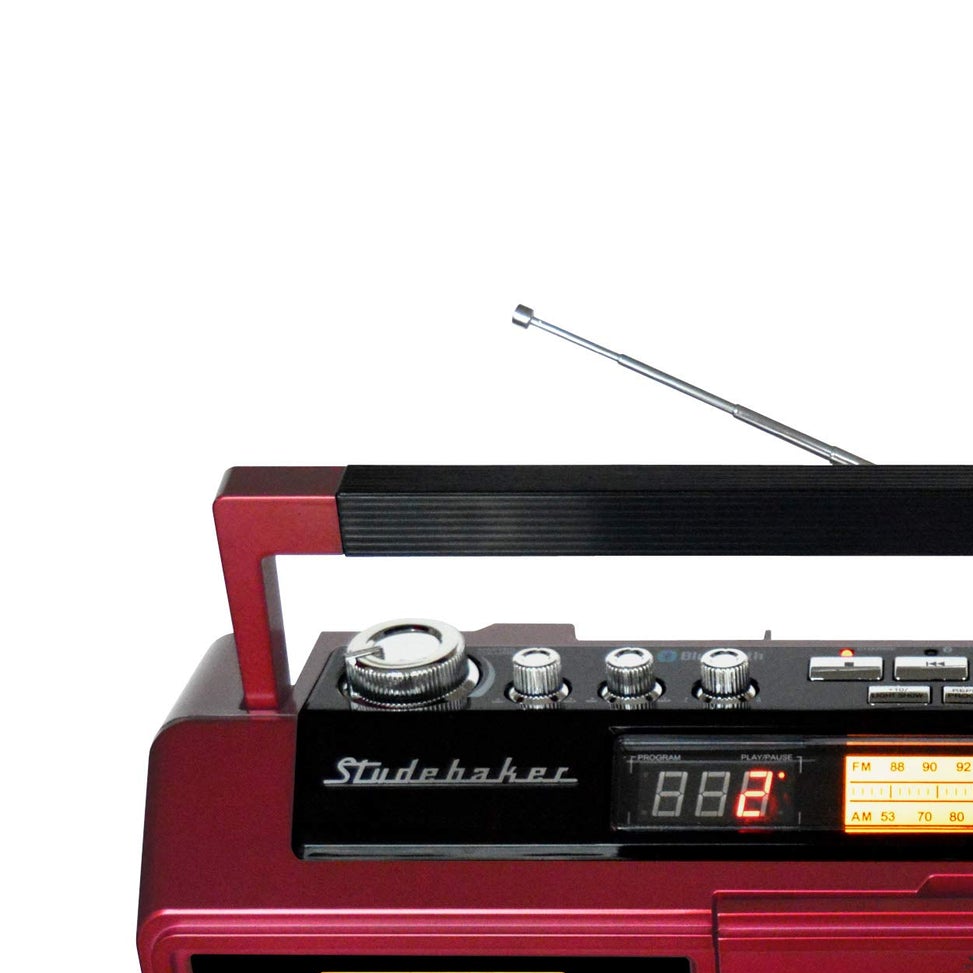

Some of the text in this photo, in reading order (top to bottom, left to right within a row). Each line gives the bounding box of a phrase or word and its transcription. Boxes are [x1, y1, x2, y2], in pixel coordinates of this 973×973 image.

[637, 753, 681, 761] PROGRAM
[740, 753, 793, 761] PLAY/PAUSE
[323, 757, 578, 787] Studebaker
[852, 762, 871, 772] FM
[890, 762, 905, 772] 88
[922, 762, 938, 772] 90
[956, 762, 971, 772] 92
[851, 812, 872, 822] AM
[880, 812, 896, 822] 53
[917, 812, 932, 822] 70
[949, 812, 965, 822] 80
